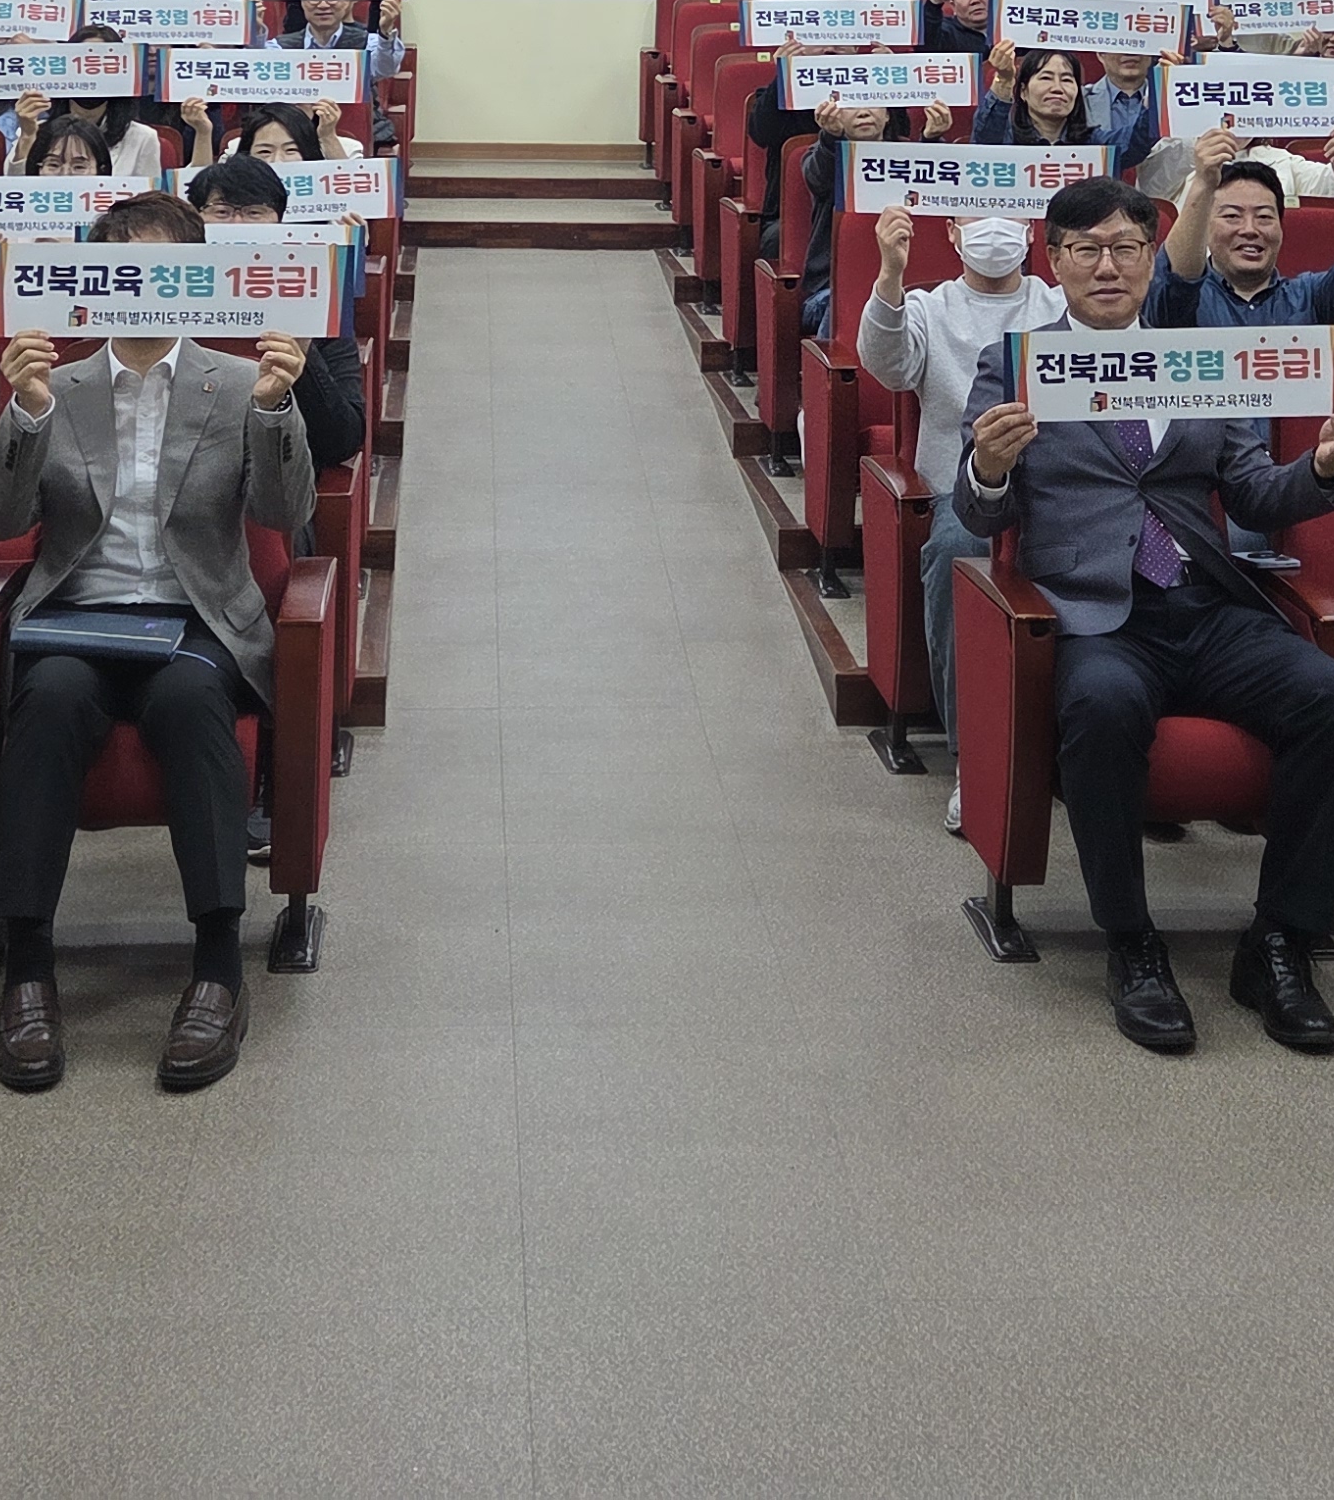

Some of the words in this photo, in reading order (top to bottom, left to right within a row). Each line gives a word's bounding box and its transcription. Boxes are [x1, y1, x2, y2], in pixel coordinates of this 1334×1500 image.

[90, 10, 153, 26] 전북교육
[156, 10, 188, 25] 청렴
[193, 3, 239, 25] 1등급!
[756, 11, 820, 27] 전북교육
[823, 11, 854, 26] 청렴
[860, 4, 905, 26] 1등급!
[1007, 6, 1079, 27] 전북교육
[1082, 11, 1118, 30] 청렴
[1124, 7, 1175, 34] 1등급!
[1225, 3, 1261, 17] 교육
[1264, 2, 1293, 16] 청렴
[28, 56, 66, 75] 청렴
[72, 48, 127, 75] 1등급!
[175, 61, 249, 80] 전북교육
[253, 62, 290, 80] 청렴
[296, 55, 350, 80] 1등급!
[796, 67, 869, 86] 전북교육
[872, 66, 907, 85] 청렴
[913, 59, 963, 84] 1등급!
[1175, 82, 1273, 107] 전북교육
[1279, 81, 1328, 107] 청렴
[319, 165, 379, 195] 1등급!
[862, 158, 961, 185] 전북교육
[966, 163, 1015, 187] 청렴
[29, 191, 72, 213] 청렴
[921, 195, 1051, 210] 전북특별자치도무주교육지원
[14, 265, 142, 297] 전북교육
[149, 264, 214, 298] 청렴
[225, 253, 317, 298] 1등급!
[91, 310, 264, 326] 전북특별자치도무주교육지원청
[1036, 352, 1157, 384] 전북교육
[1164, 351, 1224, 382] 청렴
[1234, 336, 1320, 380] 1등급!
[1111, 395, 1272, 410] 전북특별자치도무주교육지원청
